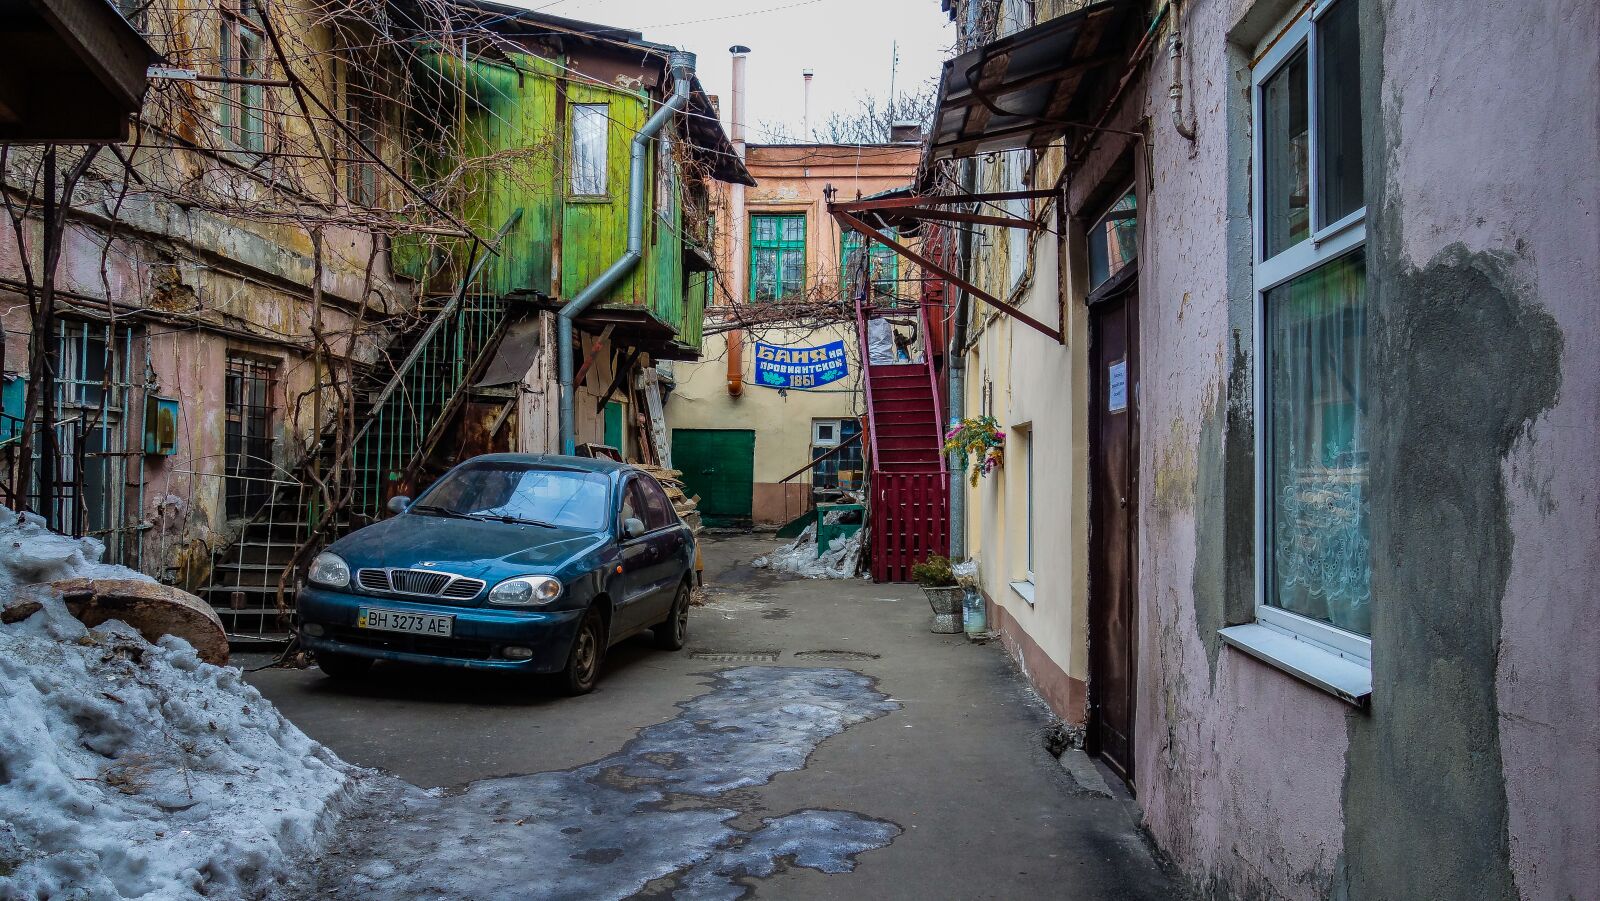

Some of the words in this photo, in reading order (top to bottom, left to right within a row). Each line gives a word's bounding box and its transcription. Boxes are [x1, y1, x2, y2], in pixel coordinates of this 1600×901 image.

[757, 346, 828, 363] БАНЯ
[828, 349, 843, 359] НА
[760, 359, 843, 374] ПРОВИАНТСКОЙ
[789, 374, 815, 387] 1861
[368, 612, 388, 628] BH
[391, 614, 424, 631] 3273
[427, 618, 446, 634] AE
